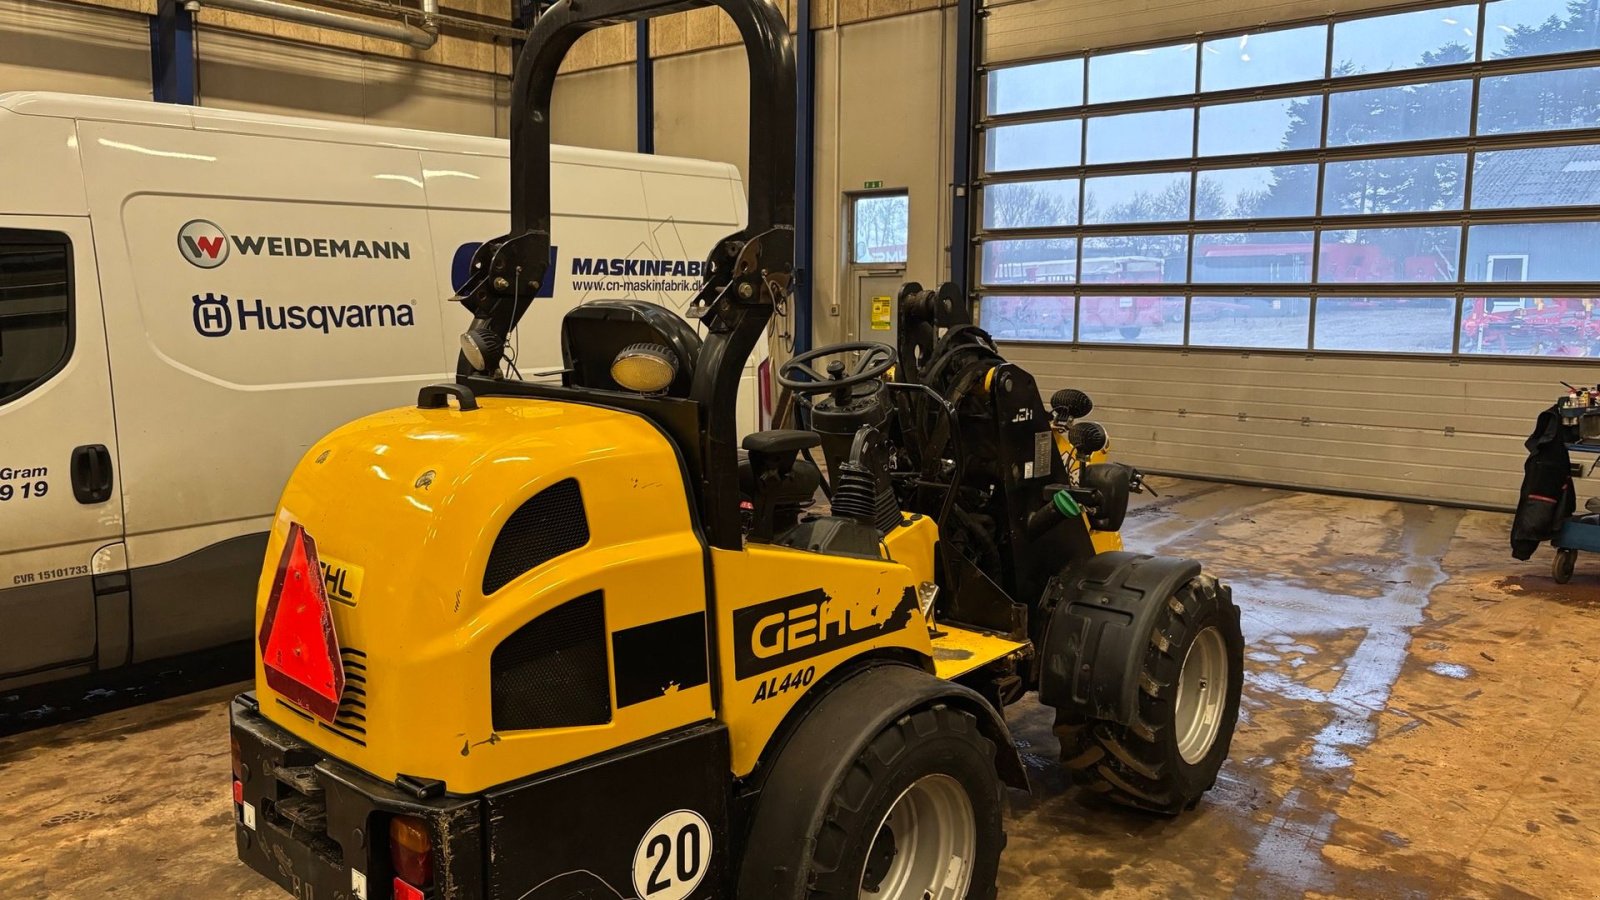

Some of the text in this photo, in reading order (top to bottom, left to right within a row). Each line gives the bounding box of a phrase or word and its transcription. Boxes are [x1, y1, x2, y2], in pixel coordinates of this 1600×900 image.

[230, 235, 411, 260] WEIDEMANN
[236, 299, 414, 334] Husqvarna
[0, 466, 48, 480] Gram
[13, 565, 88, 585] CVR 15101733
[319, 561, 353, 598] HL
[752, 665, 815, 704] AL440
[646, 823, 700, 896] 20
